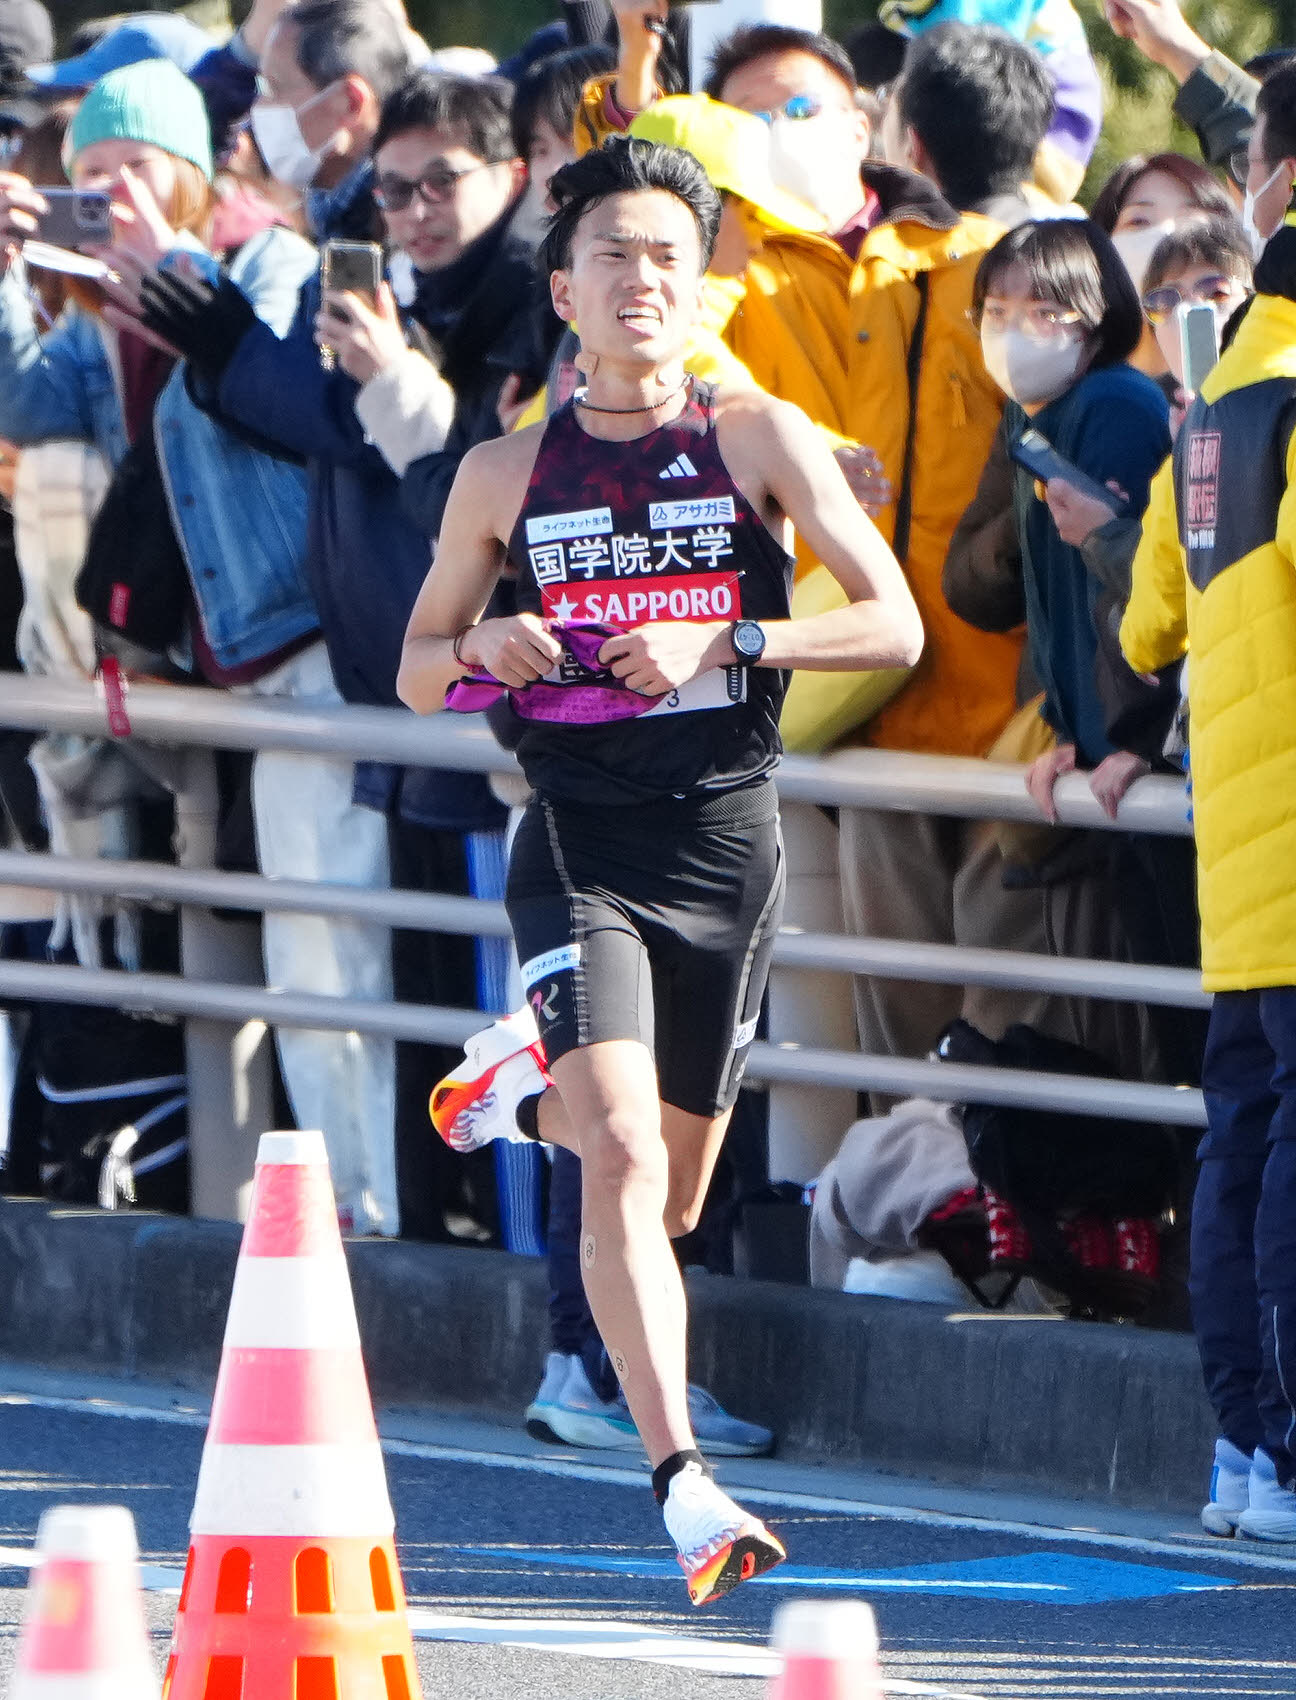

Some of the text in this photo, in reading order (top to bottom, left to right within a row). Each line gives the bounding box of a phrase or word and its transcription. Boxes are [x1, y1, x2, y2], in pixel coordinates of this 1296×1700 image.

[674, 501, 731, 519] アサガミ
[543, 515, 610, 532] ライフネット生命
[528, 525, 734, 585] 国学院大学
[584, 585, 733, 622] SAPPORO
[667, 688, 680, 708] 3
